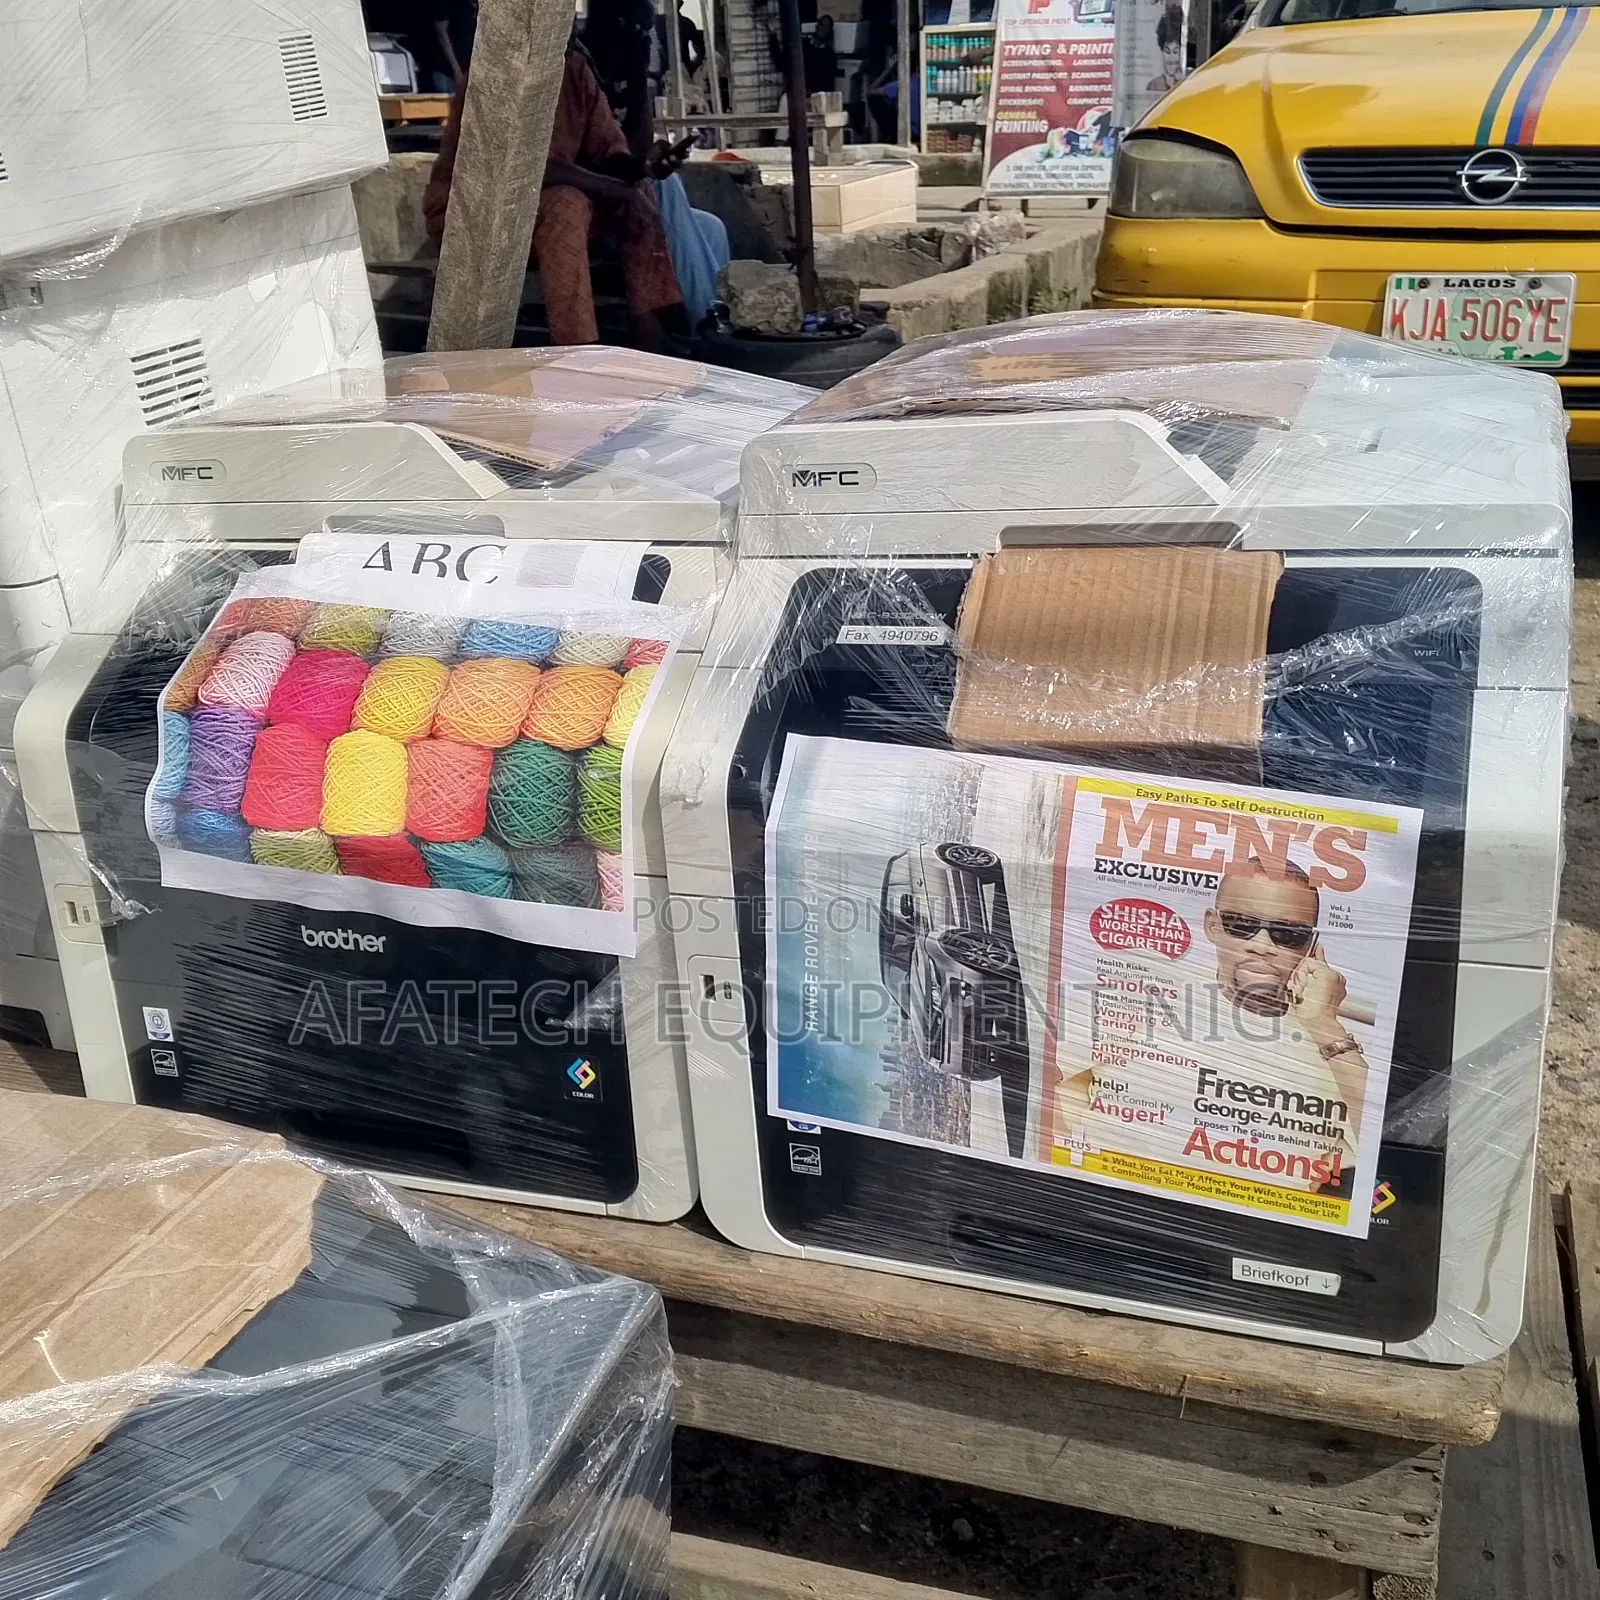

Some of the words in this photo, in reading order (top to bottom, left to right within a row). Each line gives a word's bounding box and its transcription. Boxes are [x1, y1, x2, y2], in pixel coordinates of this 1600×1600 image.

[1003, 44, 1051, 56] TYPING
[1056, 43, 1066, 55] &
[1070, 71, 1111, 79] SCANNING
[996, 110, 1038, 120] GENERAL
[994, 120, 1049, 133] PRINTING
[1443, 278, 1517, 288] LAGOS
[1390, 297, 1448, 341] KJA
[1460, 297, 1567, 342] 506YE
[161, 466, 213, 481] MFC
[792, 469, 859, 487] MFC
[845, 629, 870, 641] Fax
[878, 630, 939, 641] 4940796
[1135, 788, 1162, 800] Easy
[1165, 792, 1199, 805] Paths
[1203, 797, 1217, 807] To
[1220, 799, 1247, 811] Self
[1249, 803, 1325, 821] Destruction
[1094, 797, 1368, 892] MEN'S
[1093, 858, 1218, 890] EXCLUSIVE
[1107, 876, 1126, 884] about
[1101, 903, 1184, 930] SHISHA
[1328, 920, 1354, 929] N1000
[301, 925, 387, 953] brother
[804, 911, 819, 969] ROVER
[1098, 918, 1144, 935] WORSE
[1146, 925, 1184, 941] THAN
[1098, 931, 1182, 955] CIGARETTE
[1096, 958, 1124, 969] Health
[1096, 966, 1112, 974] Real
[1114, 970, 1153, 981] Argument
[1154, 976, 1174, 985] from
[1096, 973, 1178, 999] Smokers
[804, 972, 819, 1032] RANGE
[1094, 990, 1118, 1001] Stress
[1102, 1000, 1143, 1013] Distinction
[1093, 1015, 1136, 1034] Caring
[1094, 1005, 1157, 1027] Worrying
[1161, 1017, 1173, 1027] &
[1091, 1039, 1199, 1068] Entrepreneurs
[1091, 1051, 1128, 1068] Make
[572, 1091, 594, 1099] COLOR
[1091, 1076, 1129, 1093] Help!
[1196, 1066, 1348, 1122] Freeman
[1089, 1097, 1166, 1125] Anger!
[1096, 1090, 1120, 1101] Can't
[1122, 1095, 1158, 1109] Control
[1160, 1102, 1175, 1113] My
[1193, 1097, 1345, 1140] George-Amadin
[1063, 1139, 1092, 1151] PLUS
[1193, 1117, 1229, 1132] Exposes
[1231, 1124, 1248, 1135] The
[1250, 1129, 1276, 1142] Gains
[1278, 1134, 1310, 1148] Behind
[1312, 1141, 1344, 1154] Taking
[1181, 1126, 1342, 1187] Actions!
[1111, 1156, 1137, 1169] What
[1139, 1163, 1156, 1173] You
[1158, 1166, 1173, 1176] Eat
[1175, 1170, 1196, 1182] May
[1198, 1175, 1231, 1188] Affect
[1229, 1181, 1253, 1192] Your
[1253, 1186, 1283, 1199] Wife's
[1286, 1194, 1341, 1210] Conception
[1111, 1166, 1162, 1184] Controlling
[1164, 1177, 1184, 1187] Your
[1187, 1182, 1213, 1194] Mood
[1215, 1188, 1246, 1200] Before
[1257, 1197, 1296, 1211] Controls
[1299, 1206, 1320, 1216] Your
[1322, 1209, 1340, 1219] Life
[1369, 1217, 1390, 1225] LOR
[1241, 1264, 1310, 1287] Briefkopf
